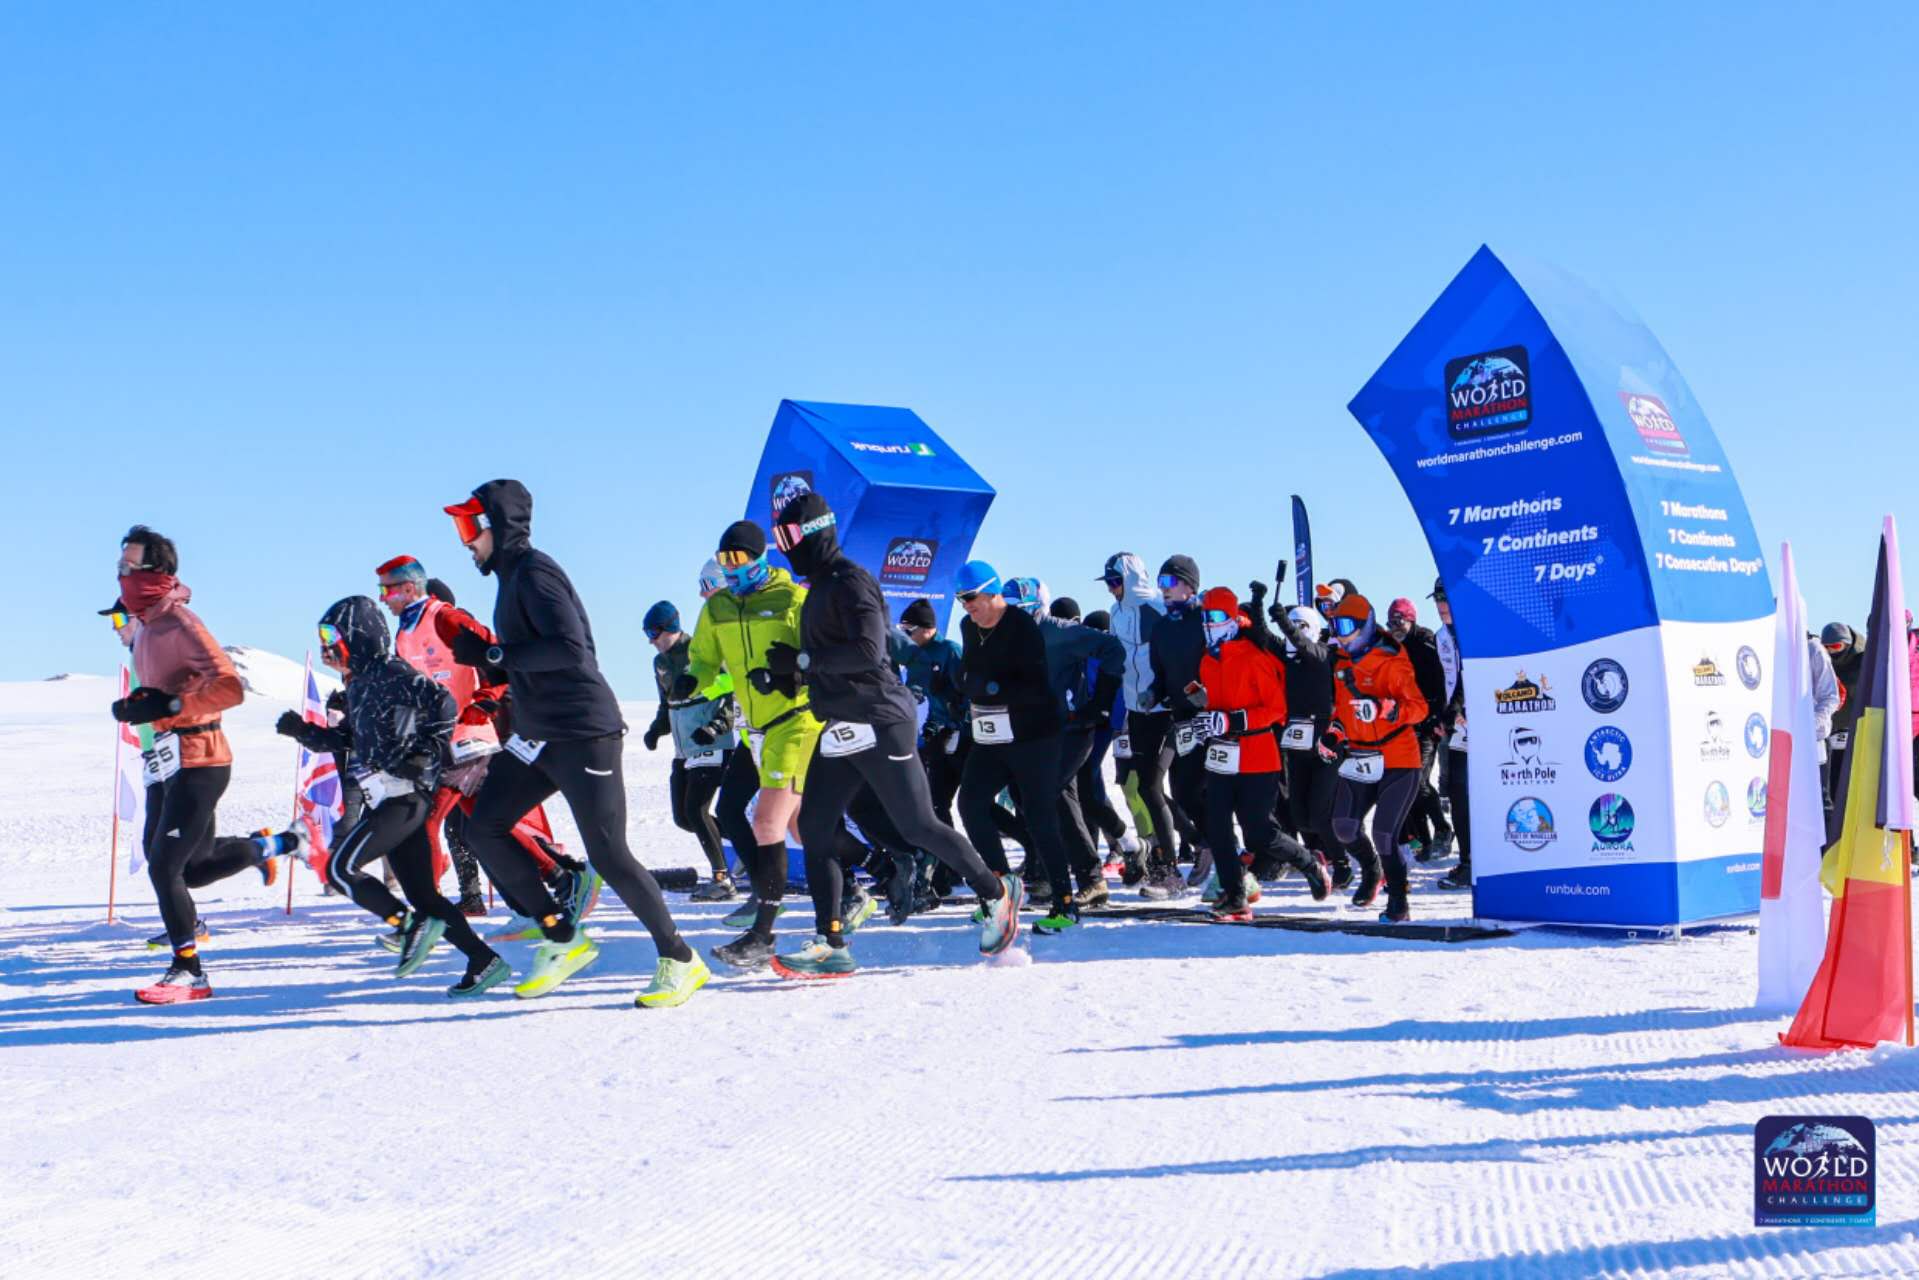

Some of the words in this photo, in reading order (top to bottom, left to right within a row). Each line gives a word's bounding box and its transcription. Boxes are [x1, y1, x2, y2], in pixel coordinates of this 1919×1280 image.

[1452, 399, 1528, 421] MARATHON
[1416, 431, 1583, 469] worldmarathonchallenge.com
[1448, 509, 1460, 525] 7
[1464, 496, 1562, 524] Marathons
[1661, 500, 1670, 516] 7
[1671, 501, 1728, 521] Marathons
[1482, 538, 1494, 555] 7
[1497, 524, 1598, 552] Continents
[1668, 528, 1676, 544] 7
[1677, 529, 1736, 547] Continents
[1656, 552, 1664, 569] 7
[1534, 565, 1546, 583] 7
[1497, 698, 1556, 714] MARATHON
[830, 726, 855, 744] 15
[978, 720, 996, 734] 13
[1209, 749, 1228, 764] 32
[1534, 767, 1556, 780] Pole
[1592, 840, 1634, 852] AURORA
[1545, 883, 1610, 896] runbuk.com
